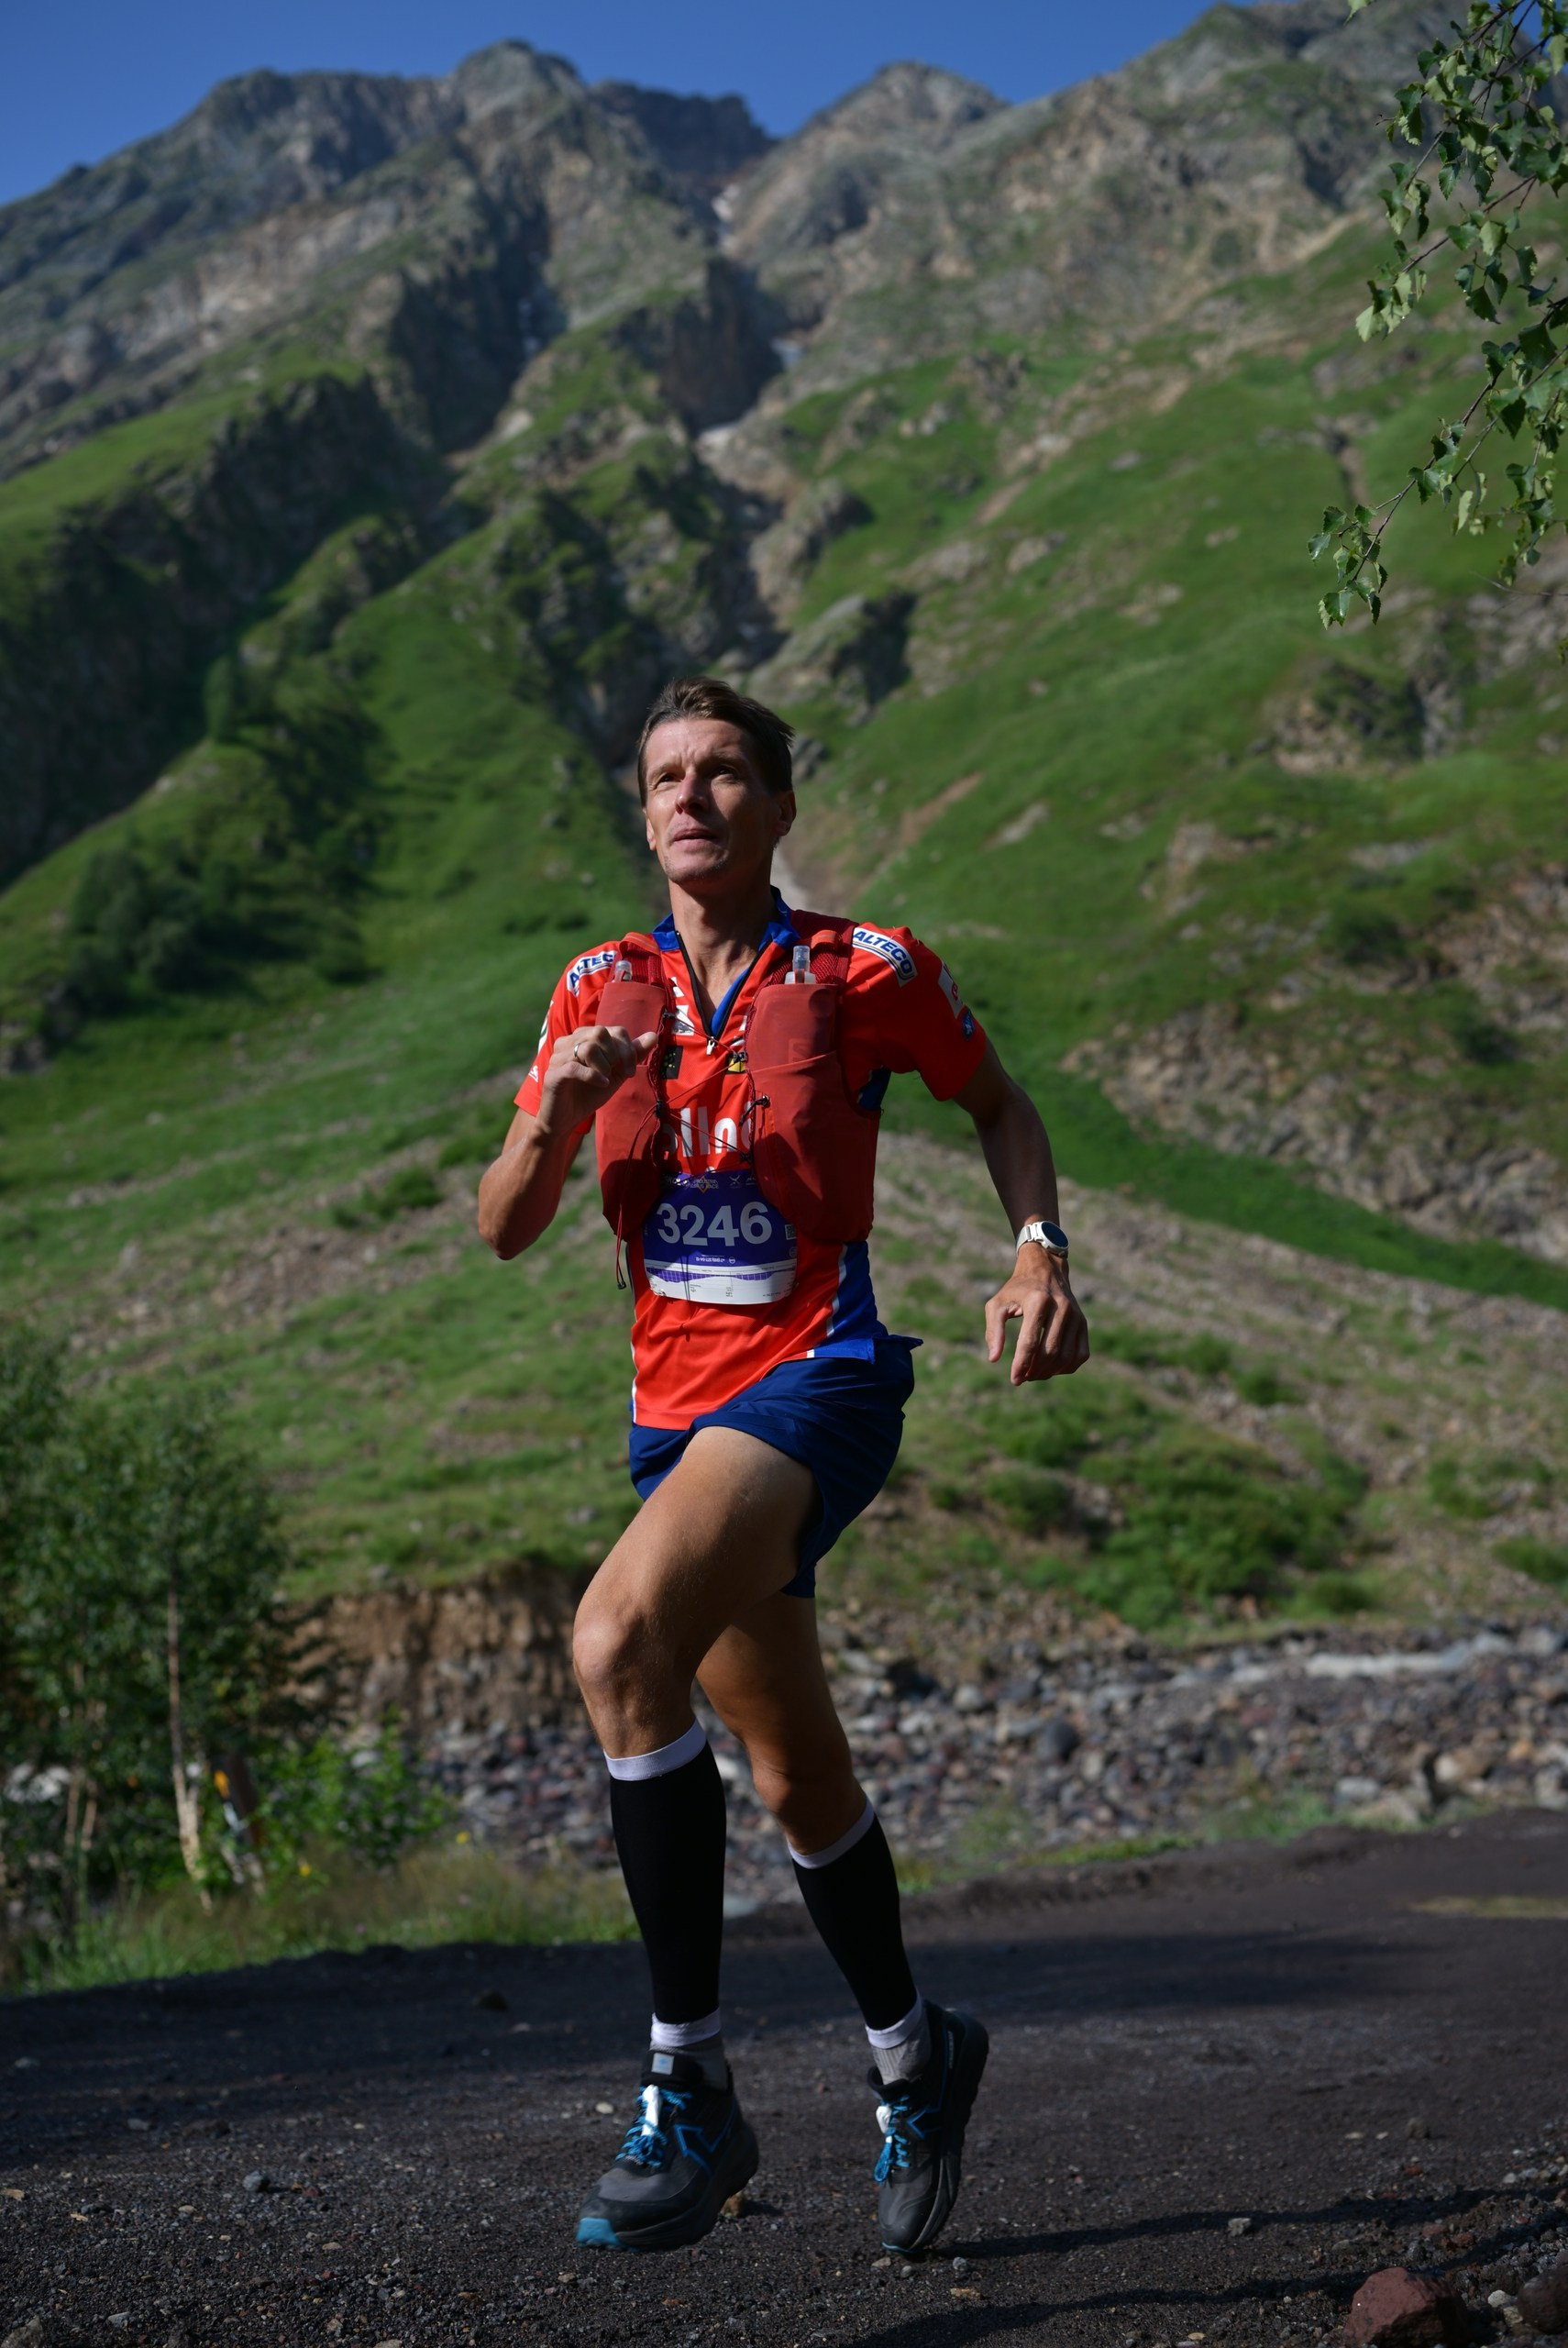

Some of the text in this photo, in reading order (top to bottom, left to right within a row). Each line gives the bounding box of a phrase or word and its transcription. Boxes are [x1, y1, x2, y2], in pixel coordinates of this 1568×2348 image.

[569, 953, 616, 989] ALTEC
[853, 930, 913, 974] ALTECO
[656, 1202, 772, 1246] 3246
